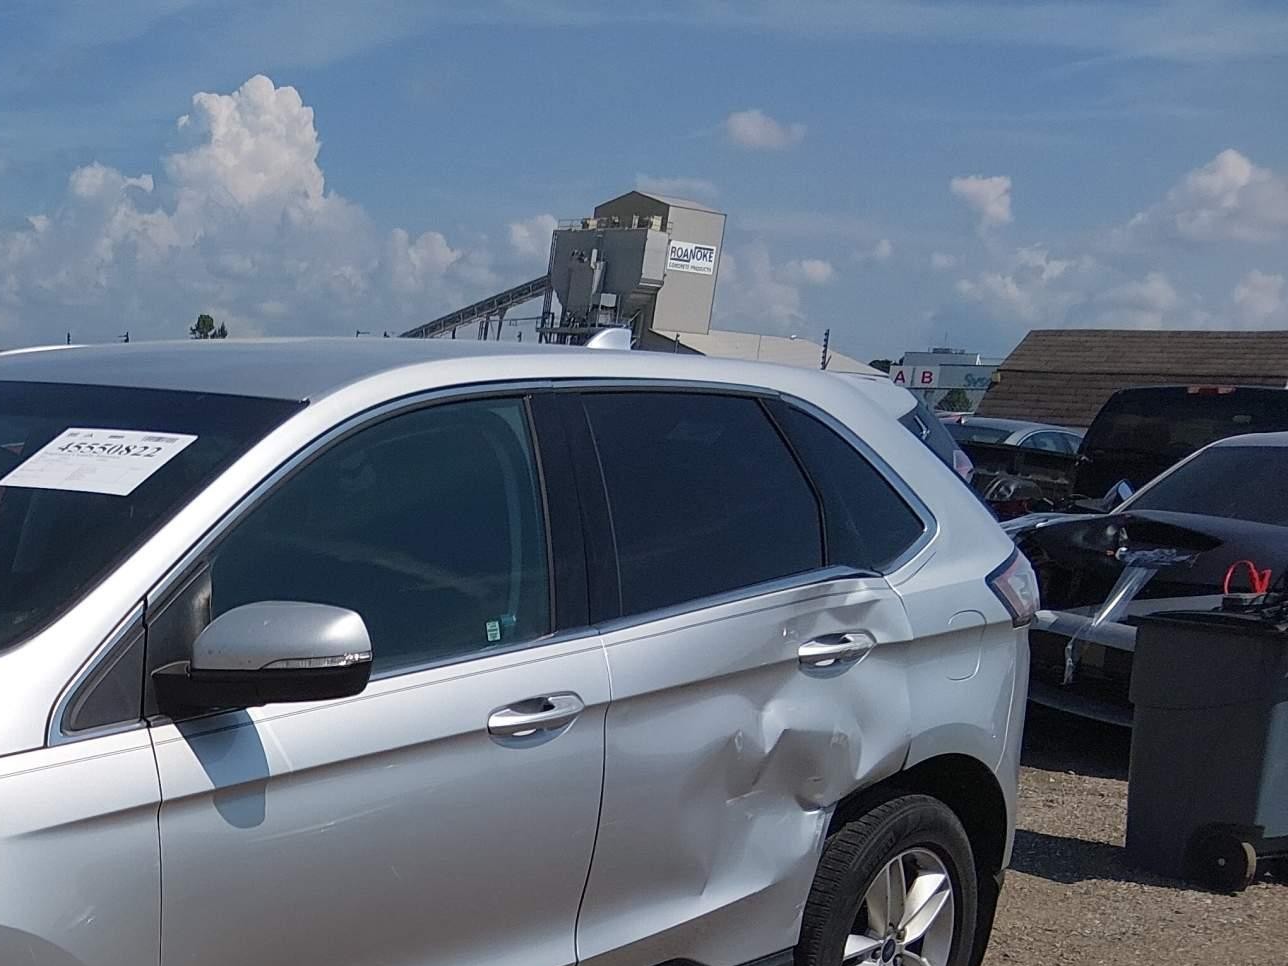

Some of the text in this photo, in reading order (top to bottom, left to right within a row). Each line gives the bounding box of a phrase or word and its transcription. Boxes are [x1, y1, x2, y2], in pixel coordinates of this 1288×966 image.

[671, 246, 714, 263] ROANOKE
[893, 370, 933, 384] A B
[58, 441, 163, 459] 45550822
